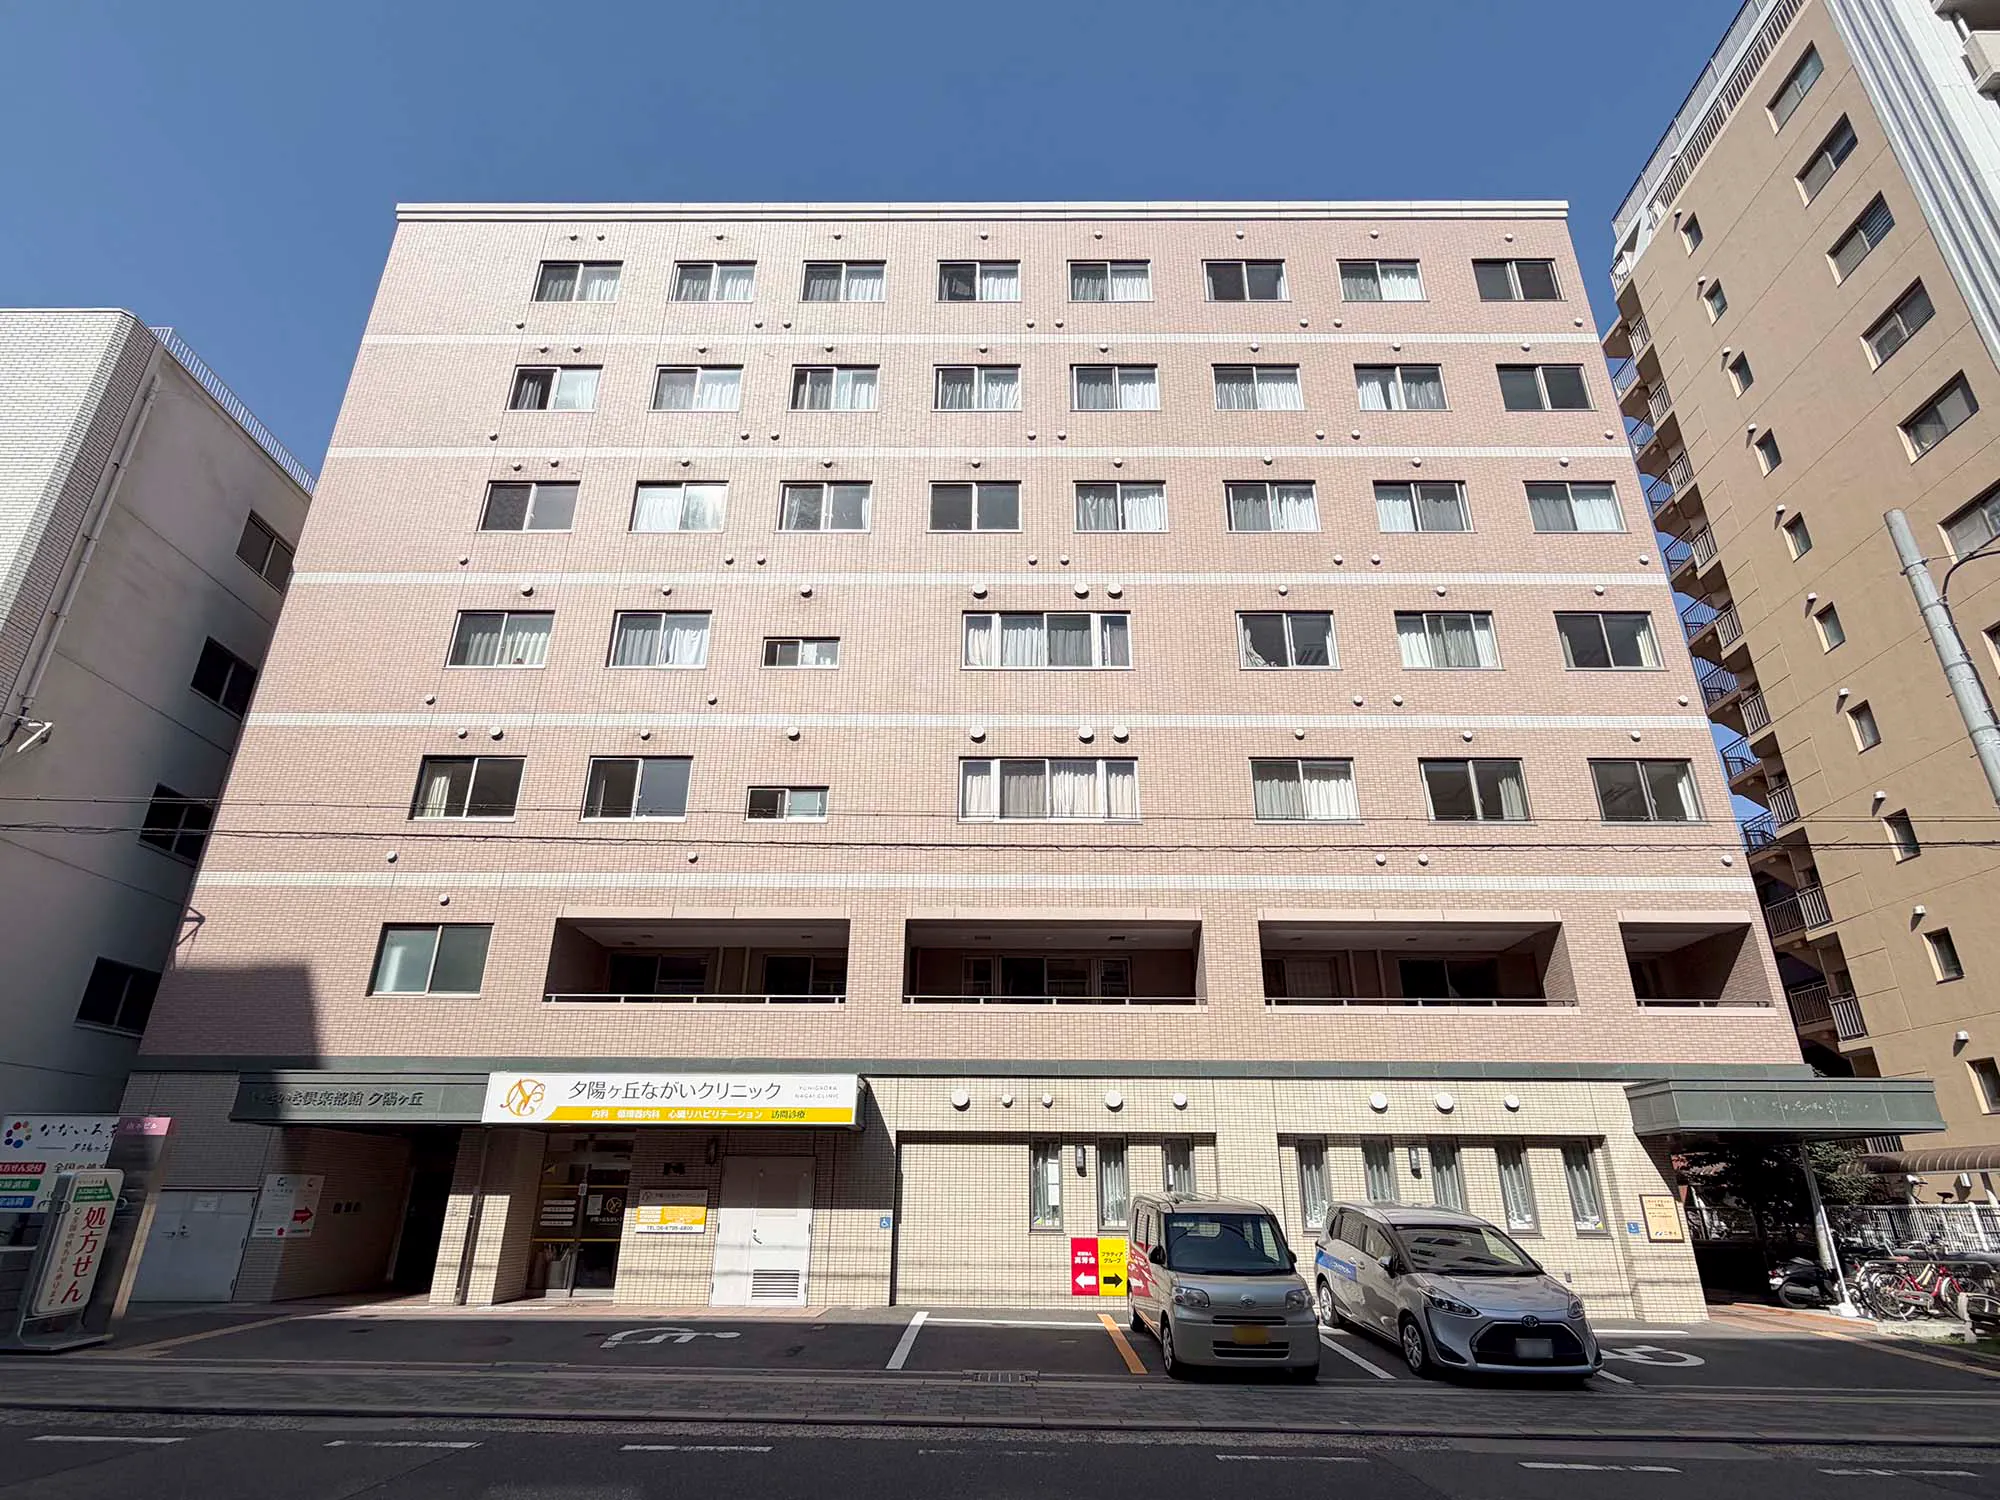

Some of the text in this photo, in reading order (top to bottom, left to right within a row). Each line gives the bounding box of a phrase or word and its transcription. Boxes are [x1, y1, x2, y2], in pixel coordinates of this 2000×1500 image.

[568, 1080, 782, 1100] 夕陽ヶ丘ながいクリニック
[60, 1206, 107, 1305] 処方せん
